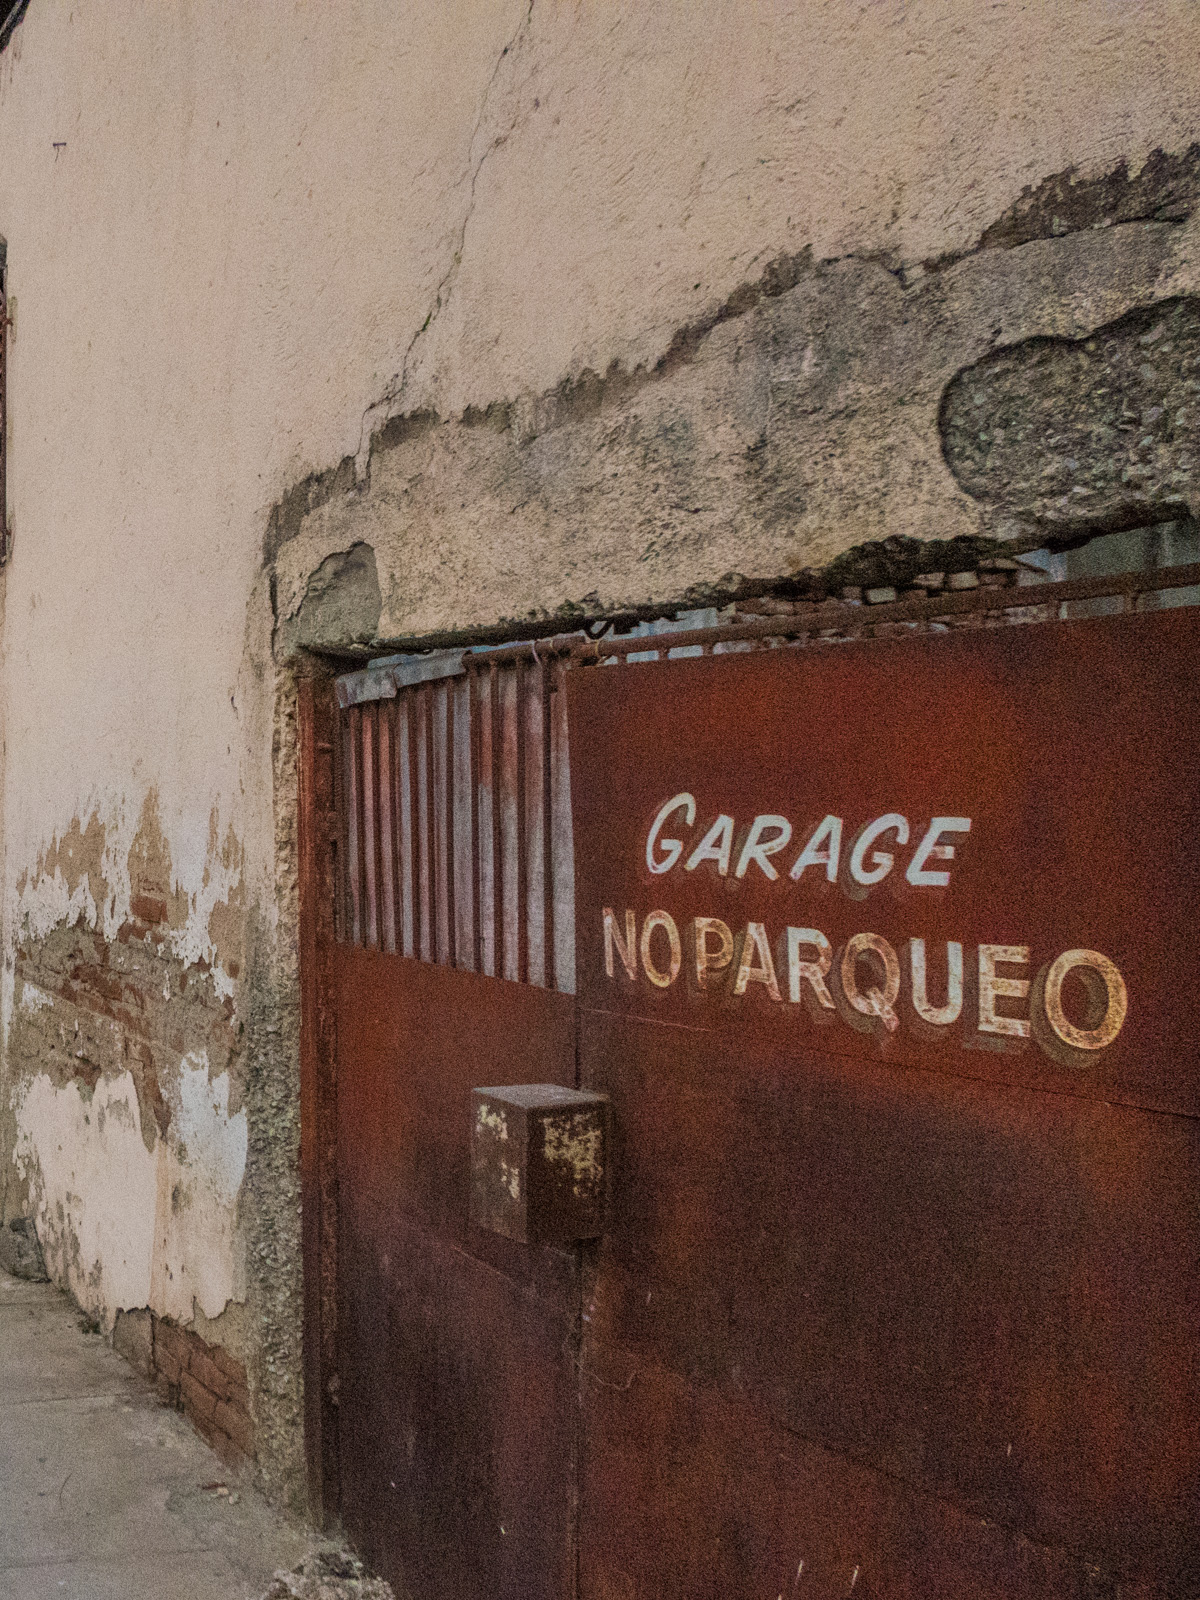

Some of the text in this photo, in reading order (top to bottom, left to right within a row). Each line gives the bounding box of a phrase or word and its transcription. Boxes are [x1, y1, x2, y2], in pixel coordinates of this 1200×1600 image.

[646, 792, 972, 887] GARAGE
[602, 906, 1129, 1050] NO PARQUEO
